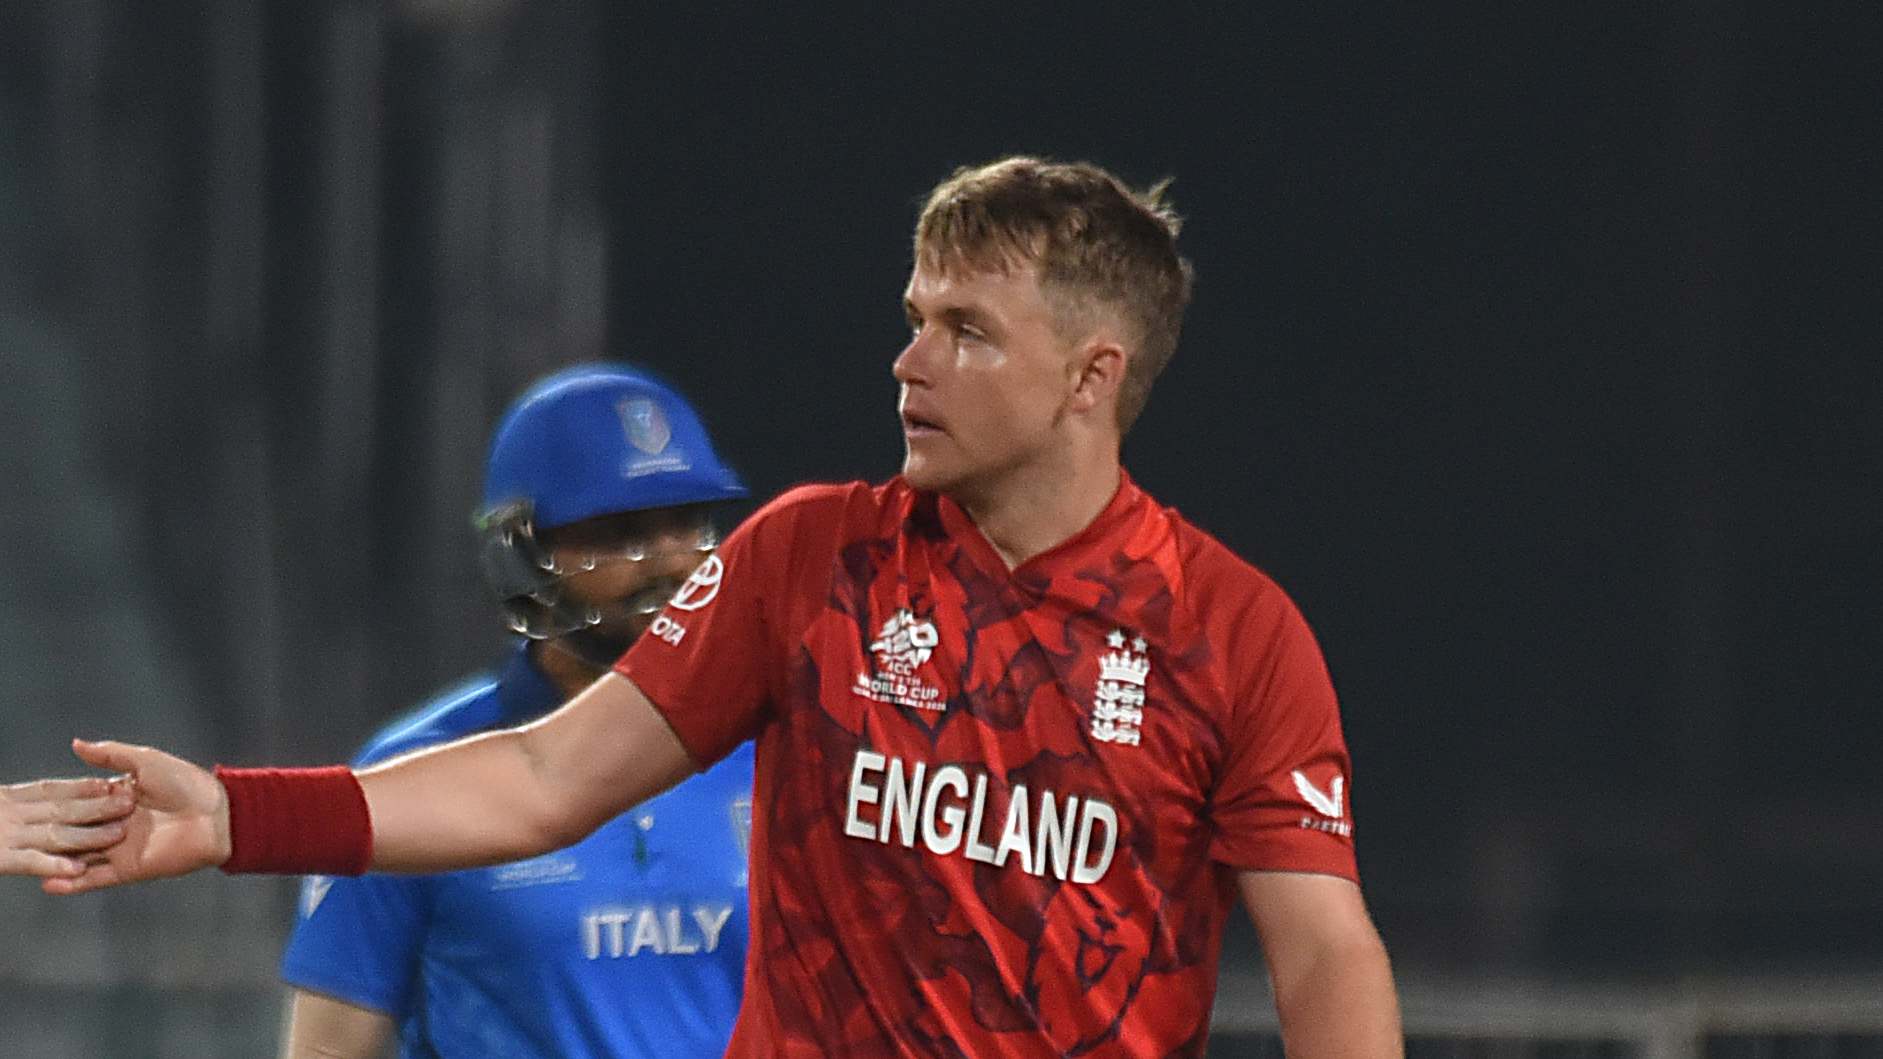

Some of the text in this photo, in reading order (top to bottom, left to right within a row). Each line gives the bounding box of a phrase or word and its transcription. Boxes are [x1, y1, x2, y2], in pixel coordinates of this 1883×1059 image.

[910, 686, 940, 702] CUP
[844, 748, 1118, 884] ENGLAND
[582, 905, 734, 960] ITALY
